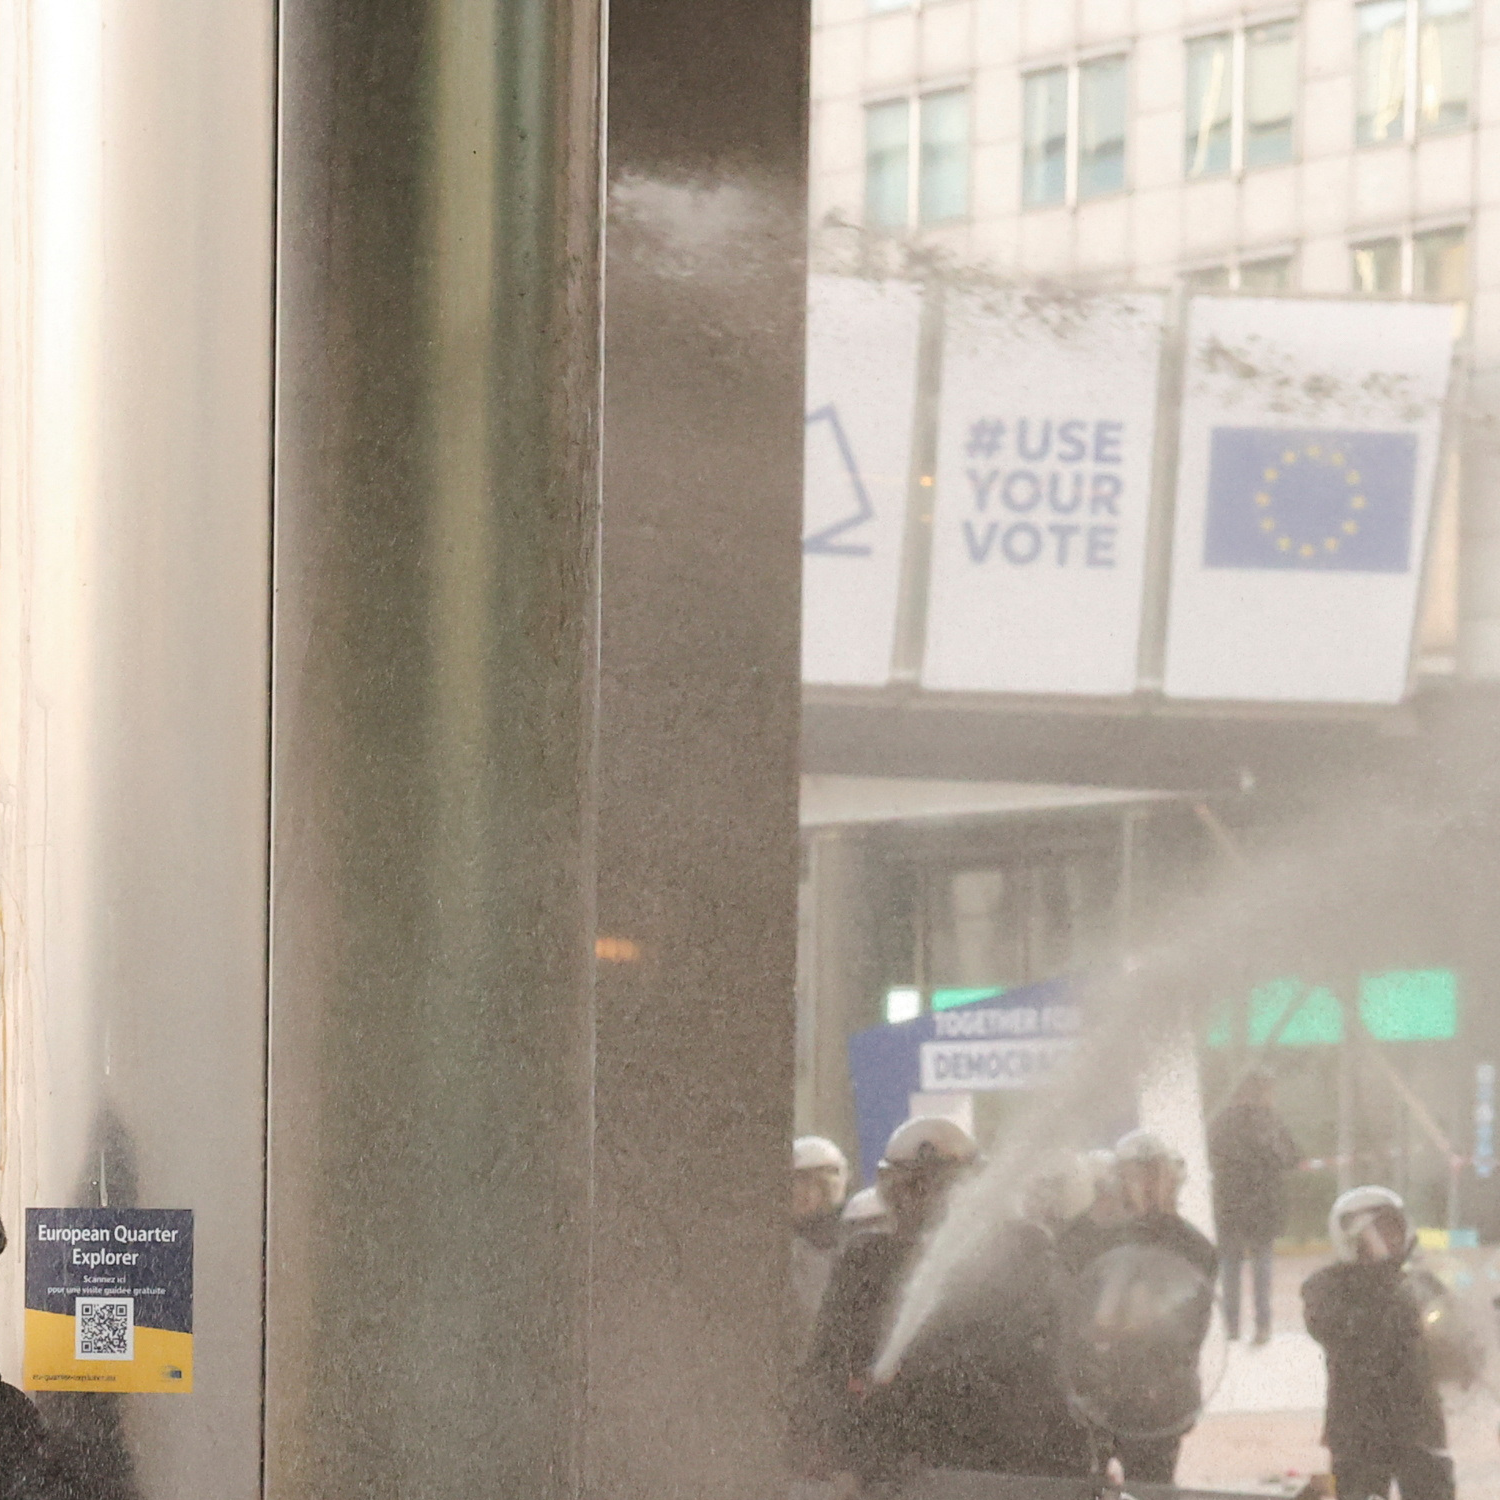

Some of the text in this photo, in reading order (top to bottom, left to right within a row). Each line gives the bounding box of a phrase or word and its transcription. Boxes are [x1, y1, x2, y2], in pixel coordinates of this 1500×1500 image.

[964, 416, 1123, 464] #USE
[965, 467, 1123, 516] YOUR
[962, 519, 1119, 568] VOTE
[38, 1224, 179, 1245] European Quarter
[72, 1248, 139, 1269] Explorer
[83, 1274, 115, 1284] Scannez
